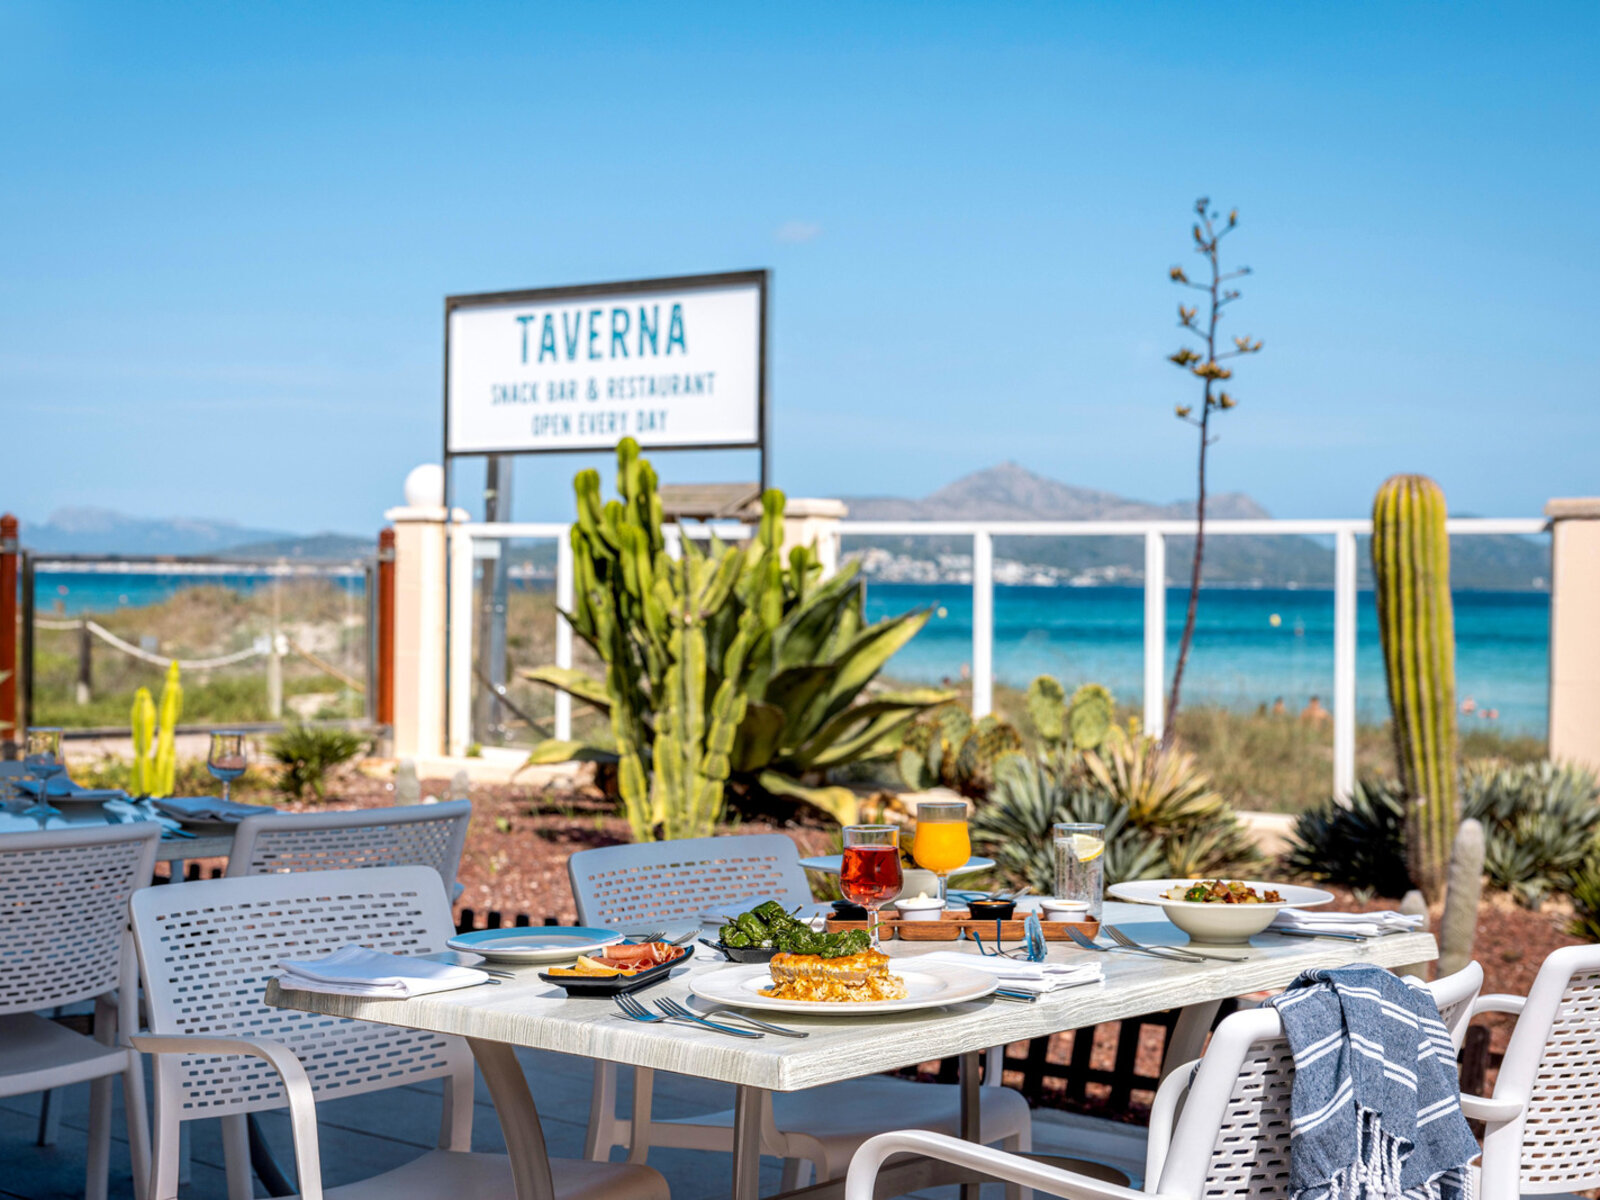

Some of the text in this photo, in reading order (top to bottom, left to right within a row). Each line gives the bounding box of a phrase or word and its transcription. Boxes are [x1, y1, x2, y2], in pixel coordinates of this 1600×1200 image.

[515, 303, 688, 364] TAVERNA
[490, 371, 716, 405] SNACK BAR & RESTAURANT
[531, 410, 669, 436] OPEN EVERY DAY
